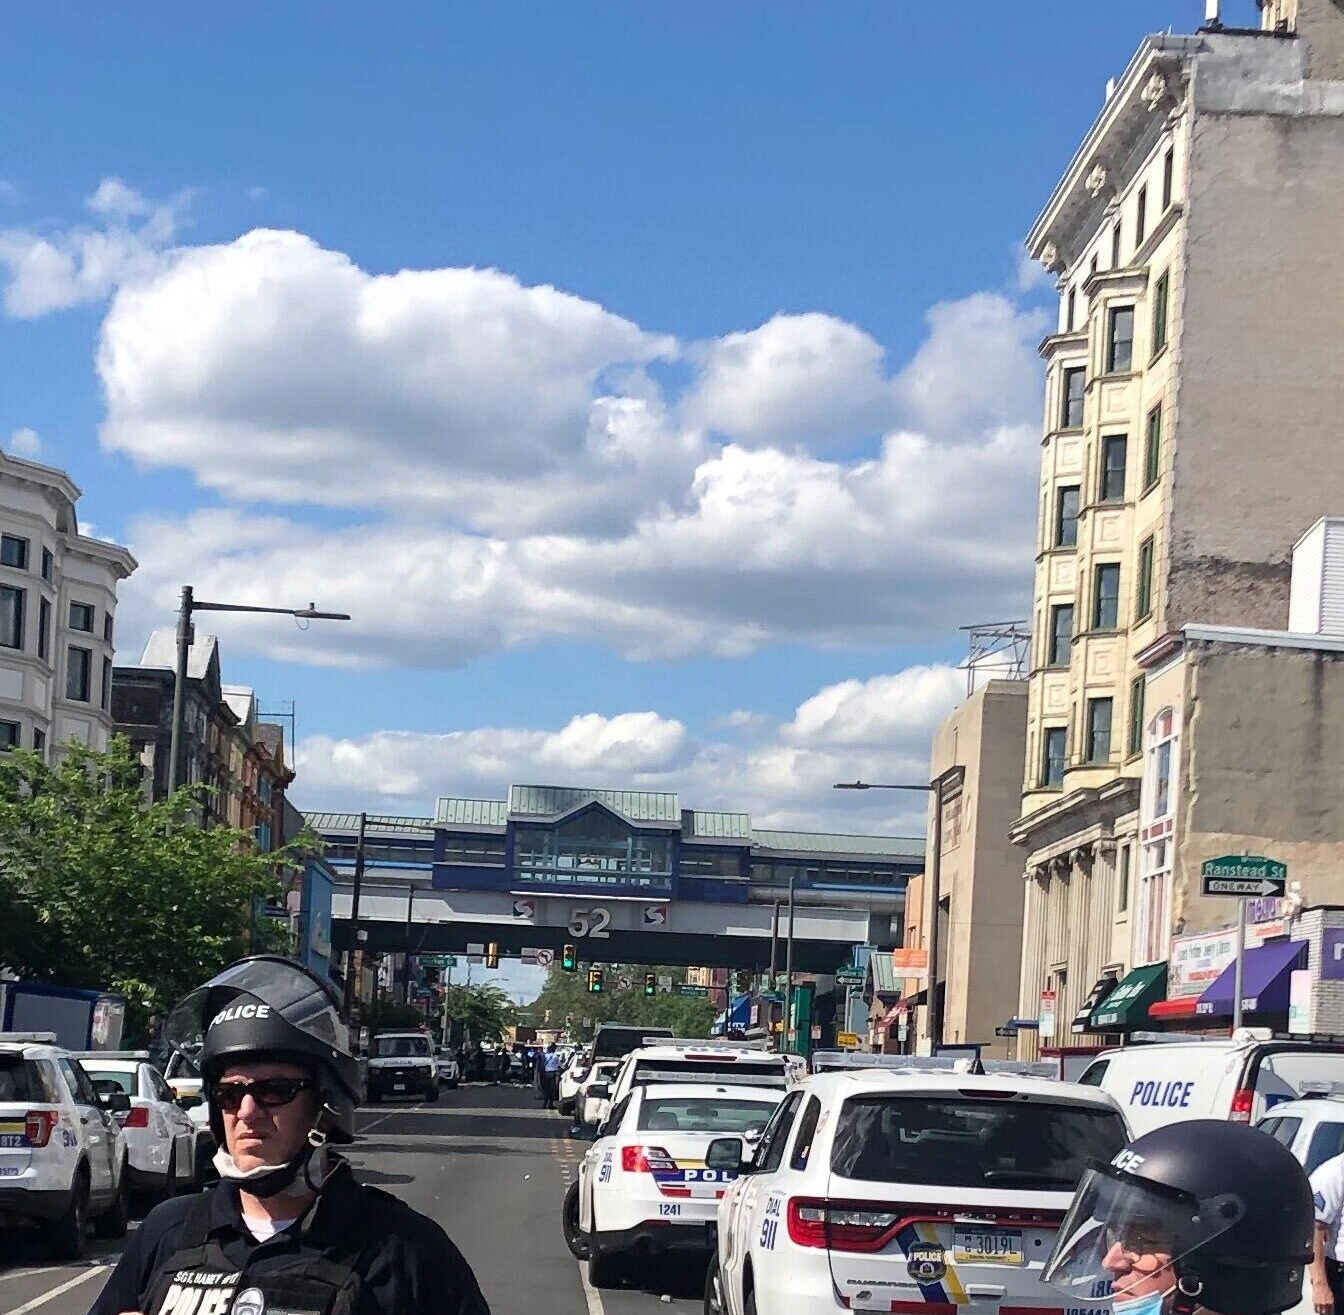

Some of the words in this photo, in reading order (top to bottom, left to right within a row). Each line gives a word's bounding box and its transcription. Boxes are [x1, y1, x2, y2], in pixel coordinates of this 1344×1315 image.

[1205, 863, 1266, 877] Ranstead
[568, 907, 611, 938] 52
[1130, 1080, 1194, 1109] POLICE
[599, 1165, 611, 1183] 911
[684, 1169, 740, 1182] POL
[658, 1204, 681, 1216] 1241
[759, 1218, 778, 1251] 911
[914, 1251, 942, 1262] POLICE
